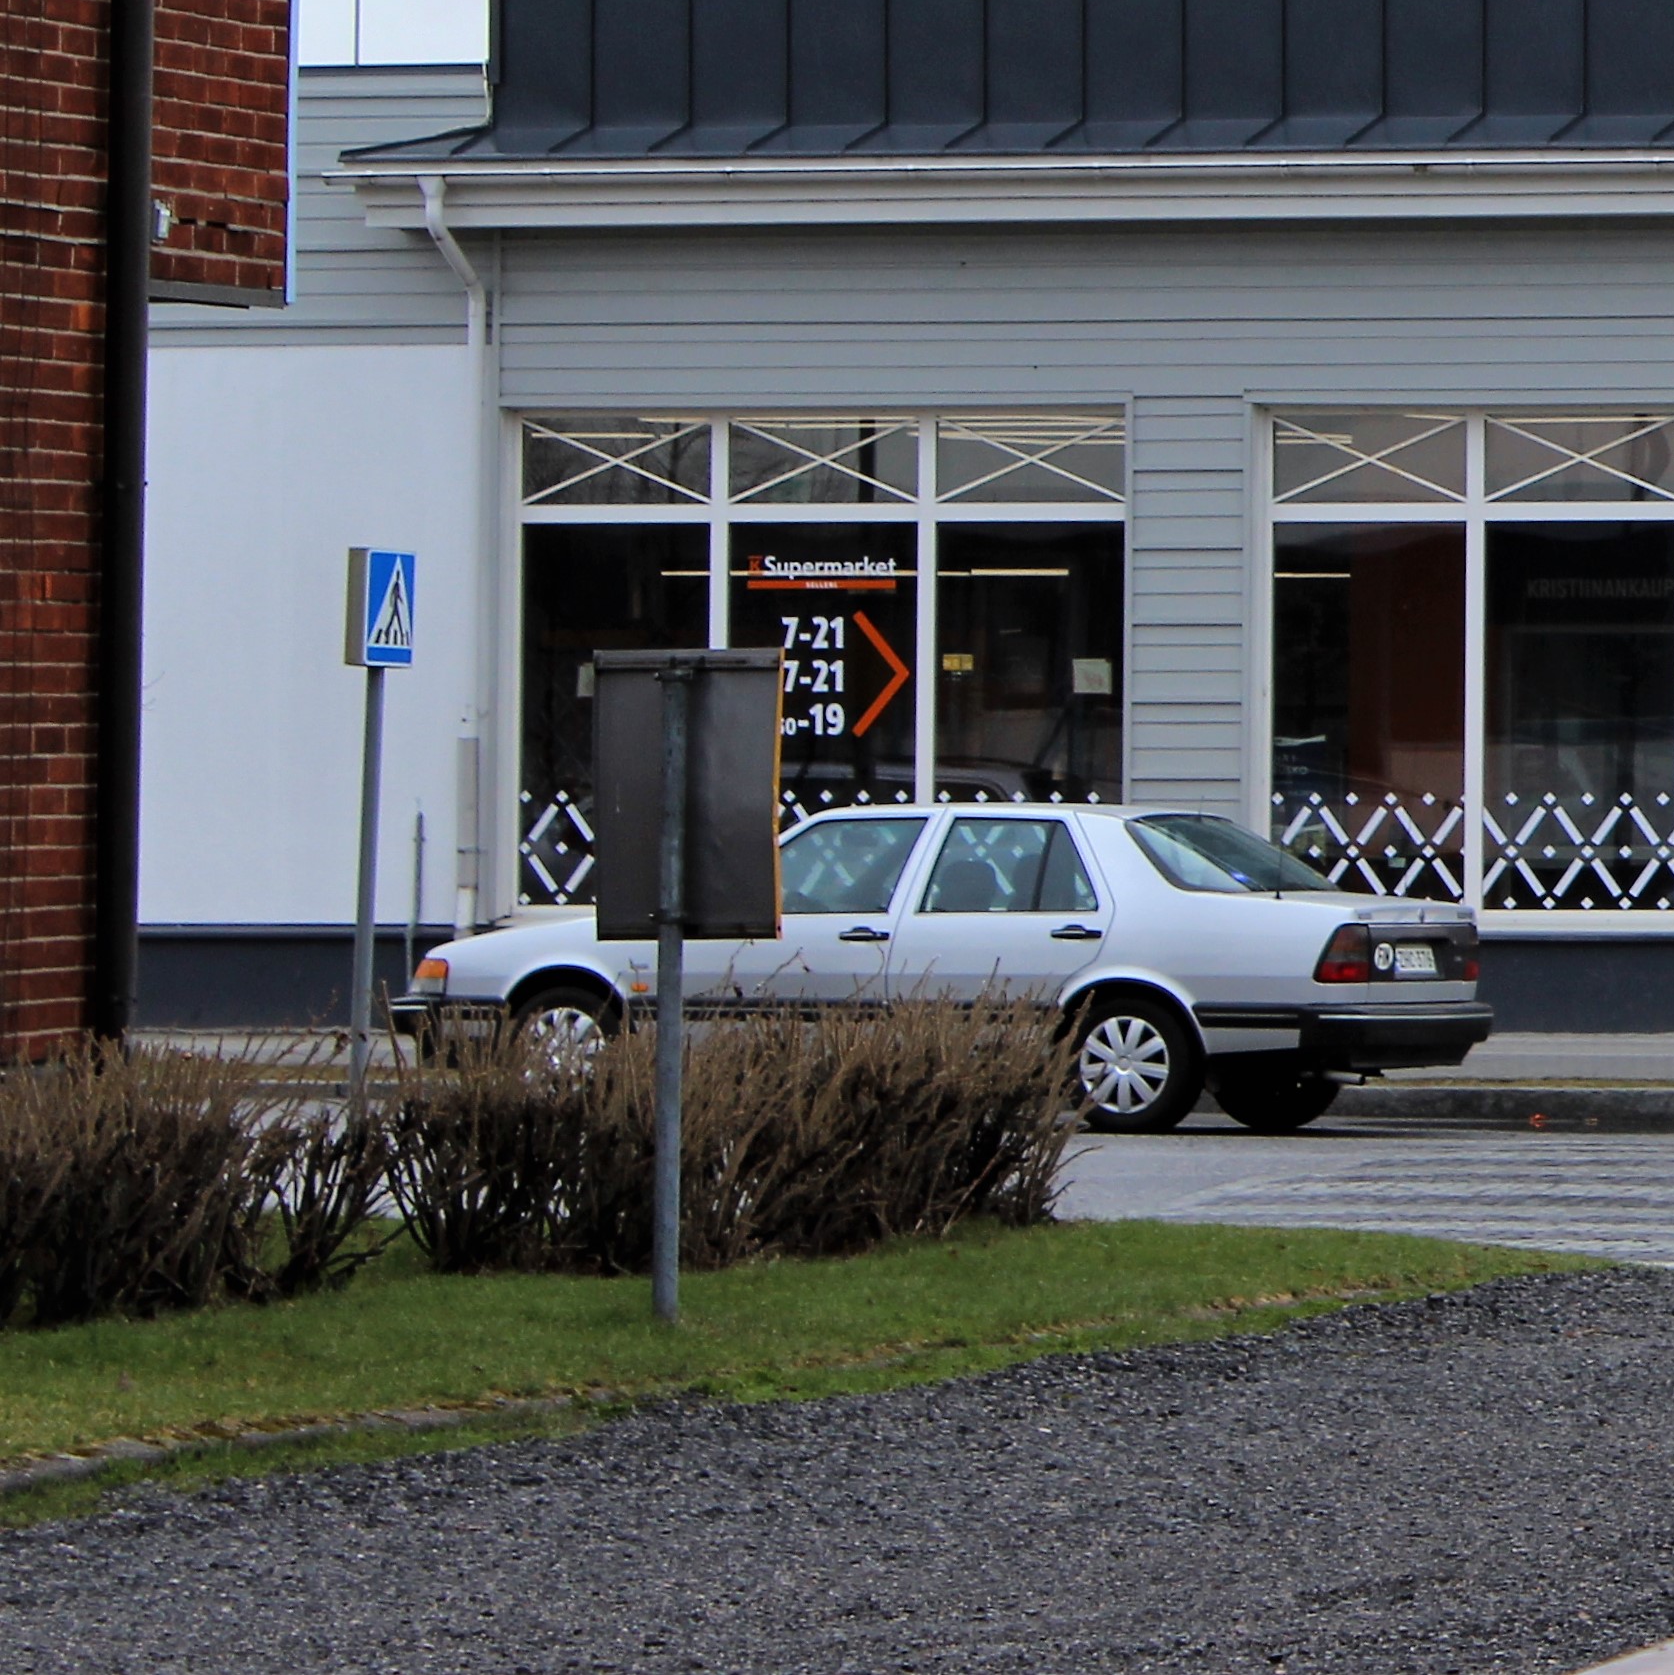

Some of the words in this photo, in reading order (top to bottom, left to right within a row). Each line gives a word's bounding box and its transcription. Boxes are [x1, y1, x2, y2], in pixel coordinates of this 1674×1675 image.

[764, 555, 896, 580] Supermarket
[782, 616, 845, 649] 7-21
[783, 660, 845, 693] 7-21
